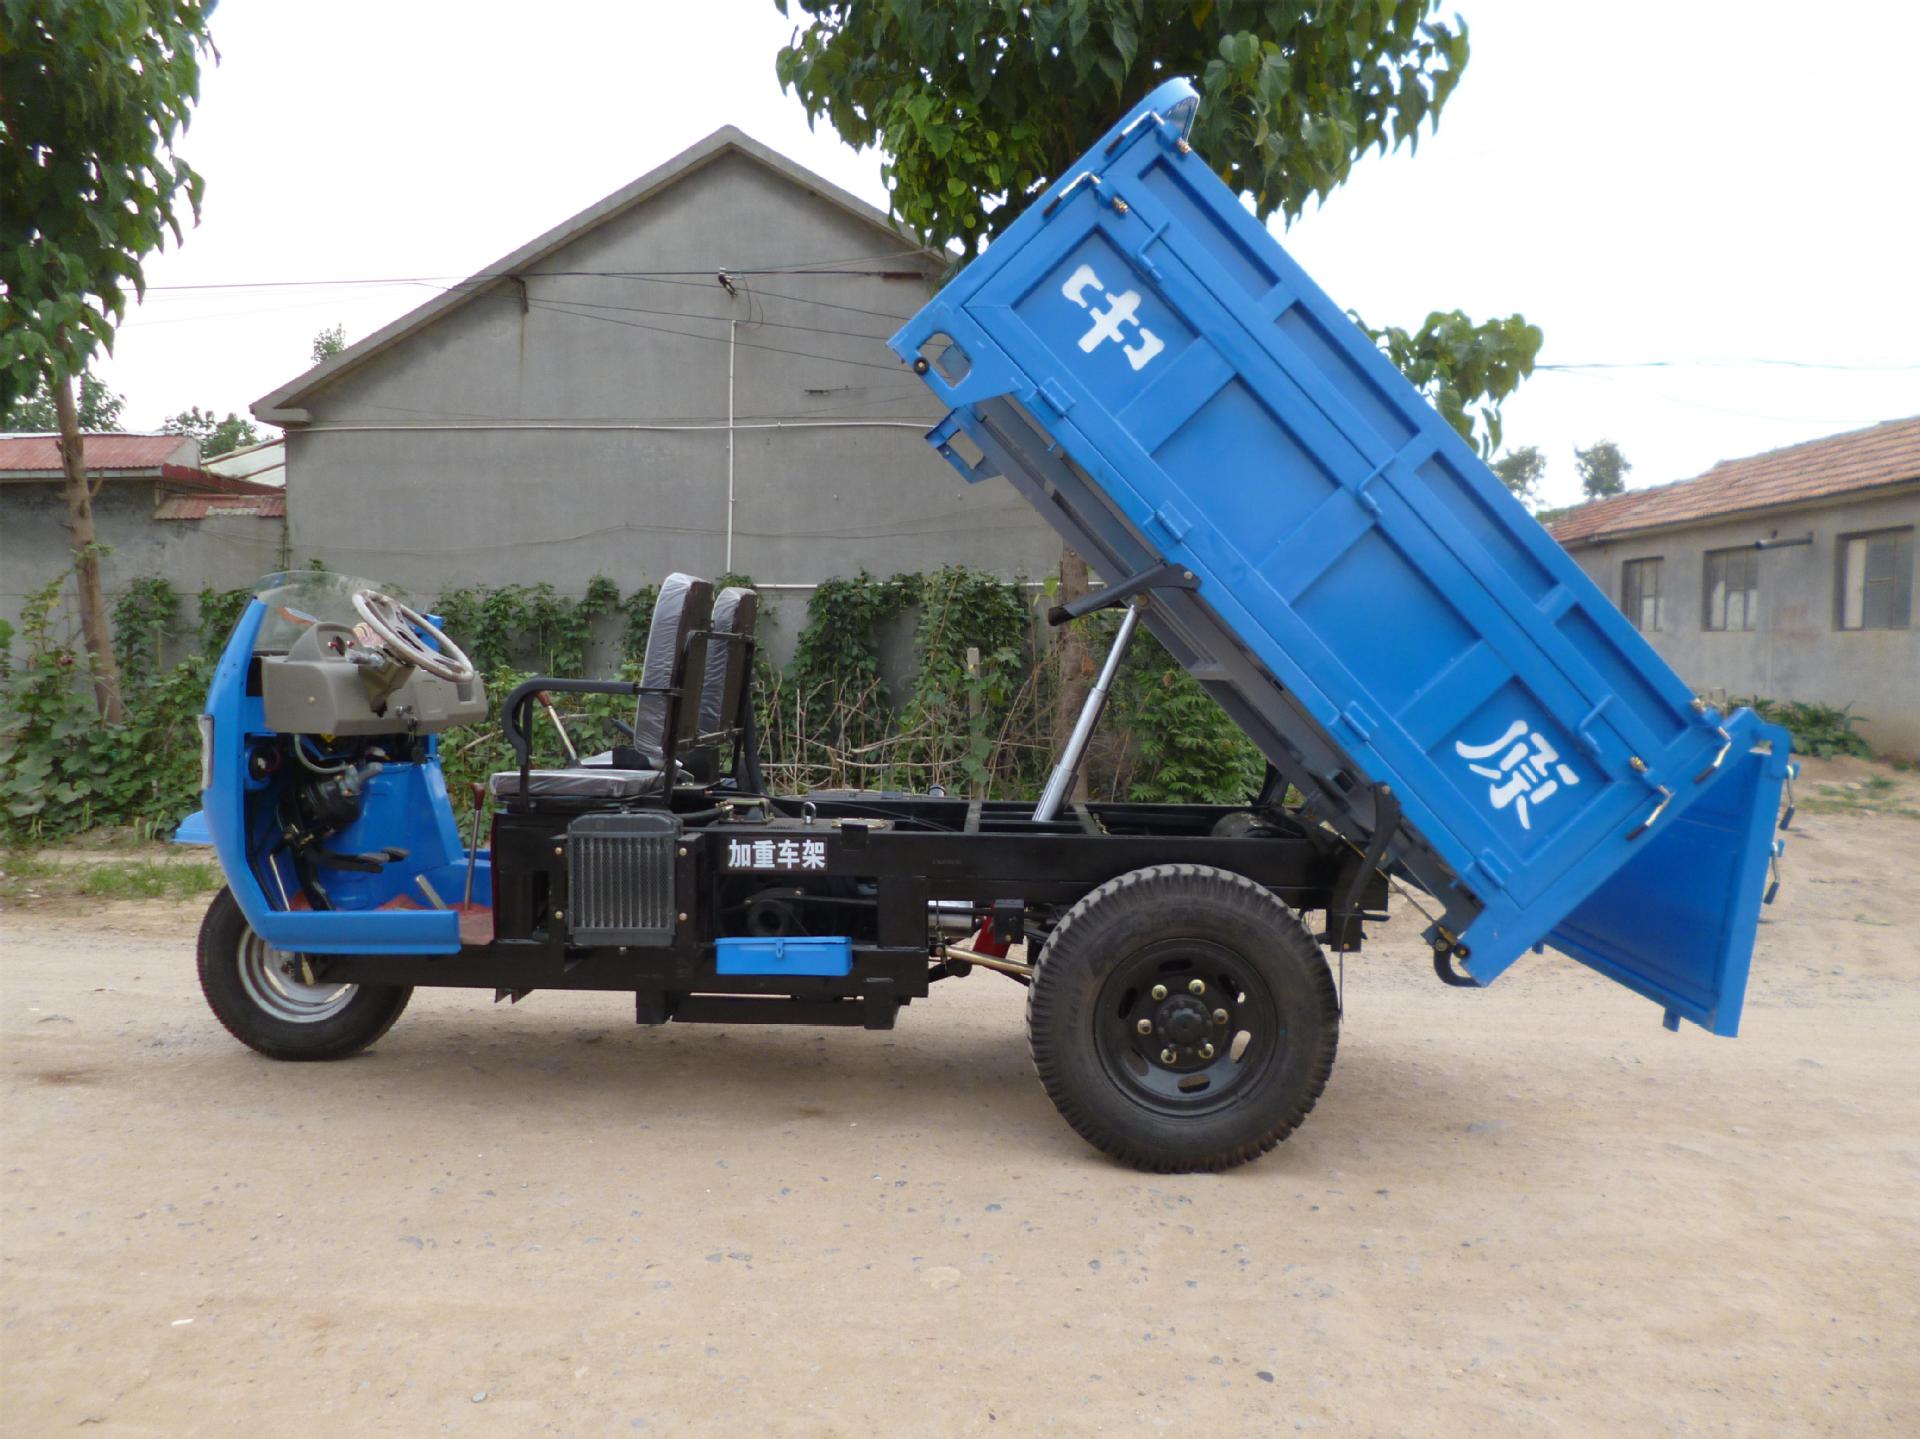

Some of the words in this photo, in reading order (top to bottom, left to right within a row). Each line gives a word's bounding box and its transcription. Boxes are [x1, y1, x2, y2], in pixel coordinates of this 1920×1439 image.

[1062, 264, 1165, 371] 中
[1455, 719, 1580, 830] 原
[728, 838, 826, 869] 加重车架
